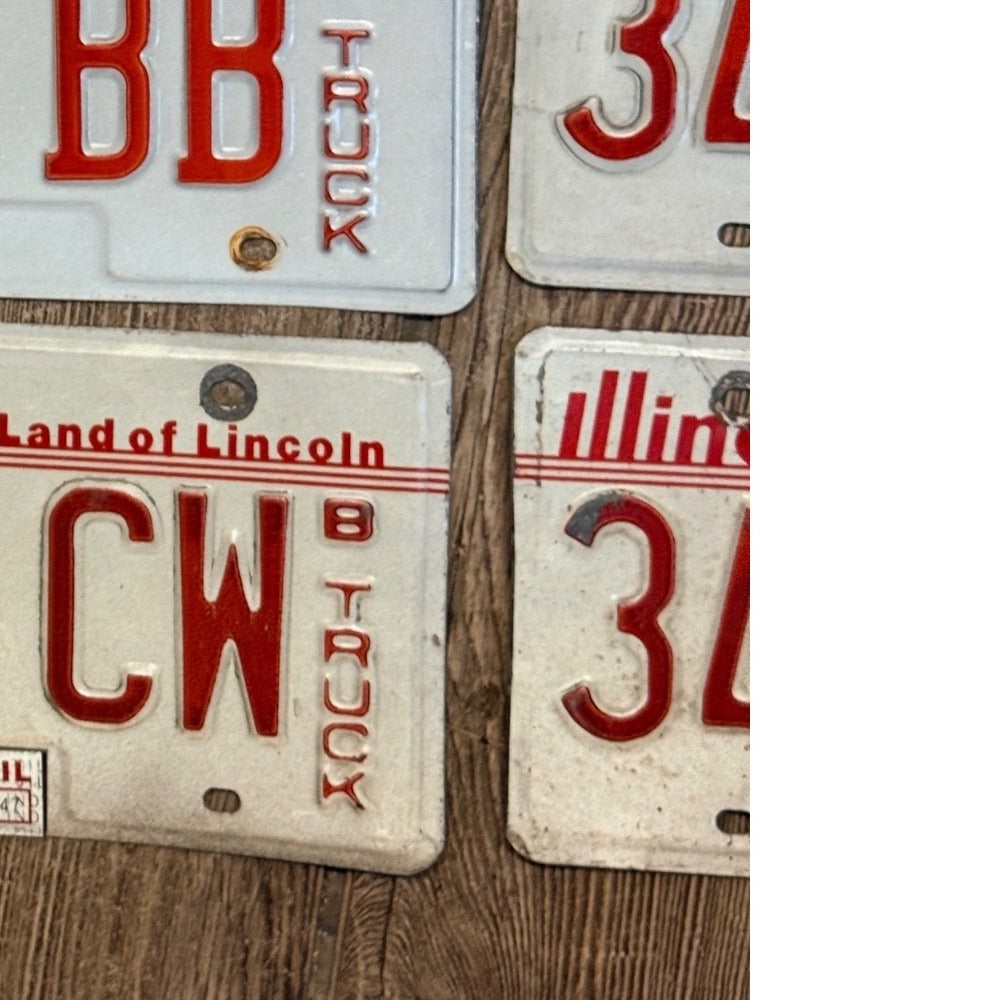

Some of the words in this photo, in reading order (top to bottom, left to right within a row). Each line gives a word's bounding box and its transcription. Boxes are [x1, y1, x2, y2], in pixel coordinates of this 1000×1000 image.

[322, 29, 370, 255] TRUCK
[128, 420, 178, 456] of
[198, 422, 385, 468] Lincoln
[557, 369, 750, 467] Illin
[323, 497, 375, 541] B
[46, 485, 289, 737] CW
[322, 580, 372, 810] TRUCK
[2, 760, 32, 782] IL
